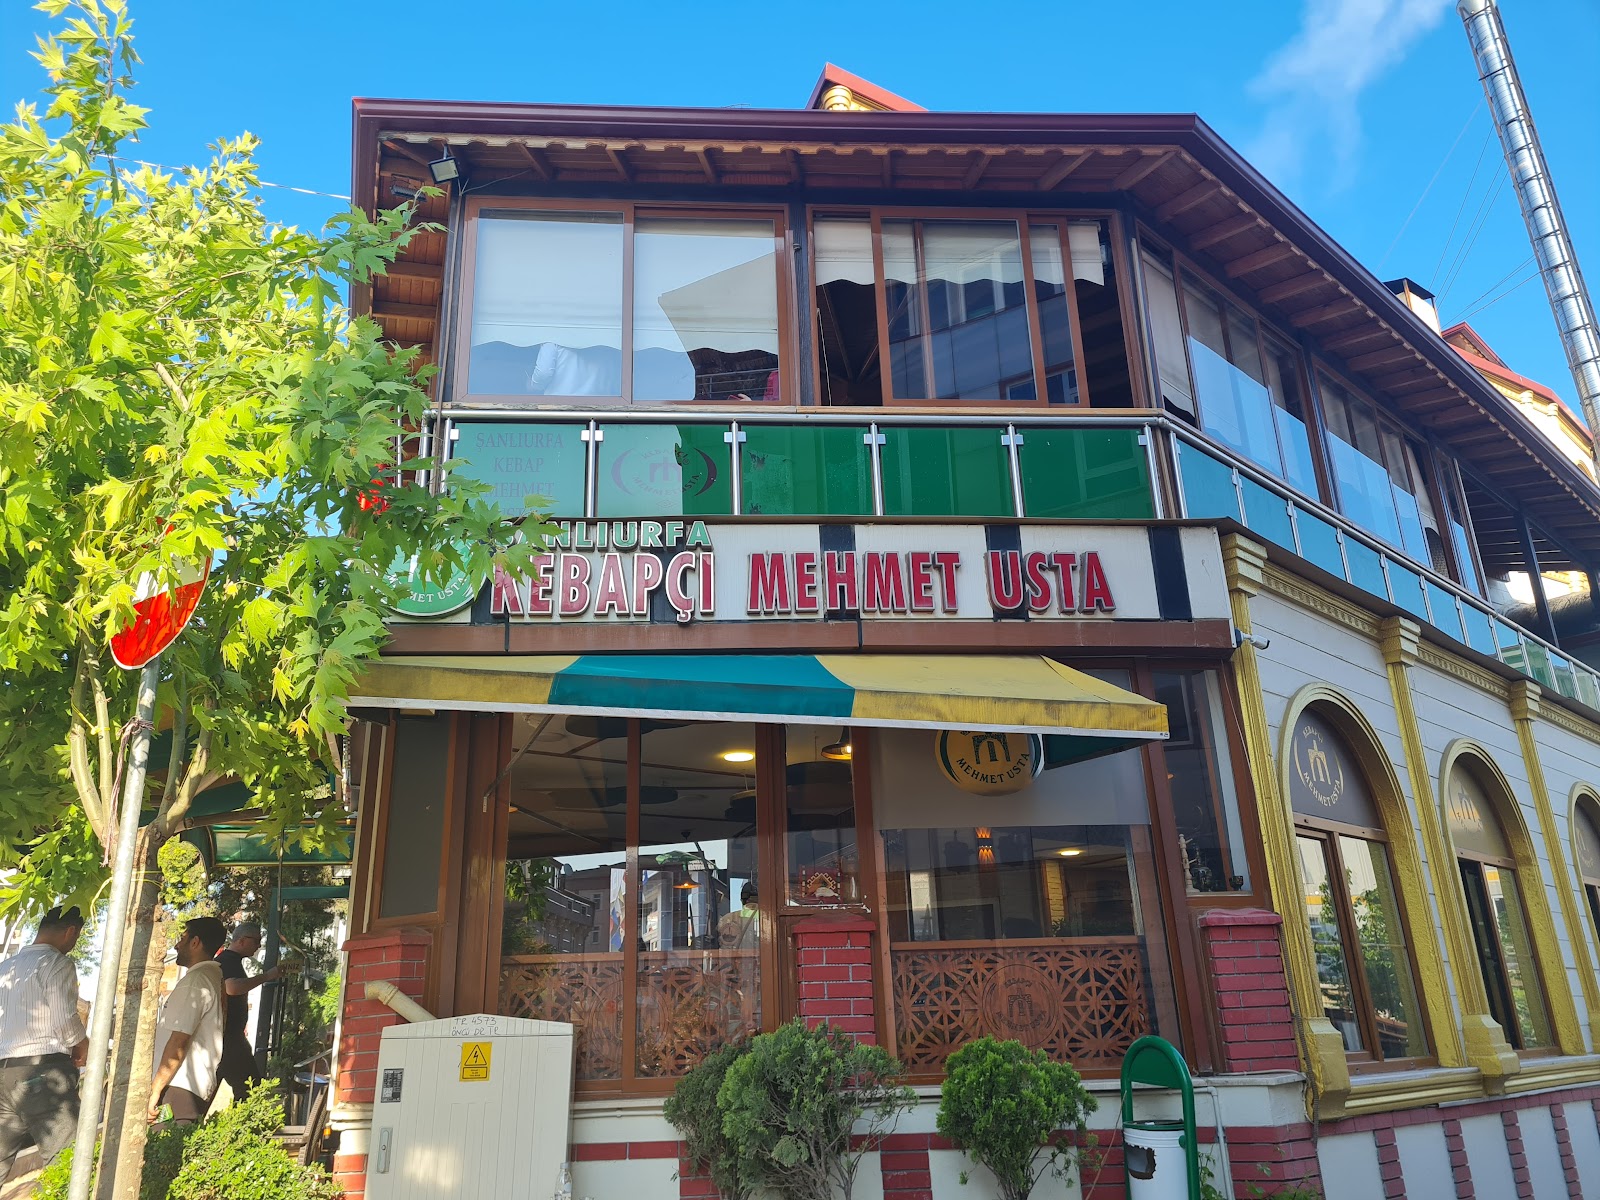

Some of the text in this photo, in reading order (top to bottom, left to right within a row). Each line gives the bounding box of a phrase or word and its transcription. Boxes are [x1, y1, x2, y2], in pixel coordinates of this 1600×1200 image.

[476, 432, 564, 453] ŞANLIURFA
[493, 457, 545, 473] KEBAP
[490, 550, 1116, 622] KEBAPÇI MEHMET USTA
[957, 752, 1030, 783] MEHMET USTA
[1303, 772, 1332, 807] MEHMET
[471, 1016, 497, 1025] 4573
